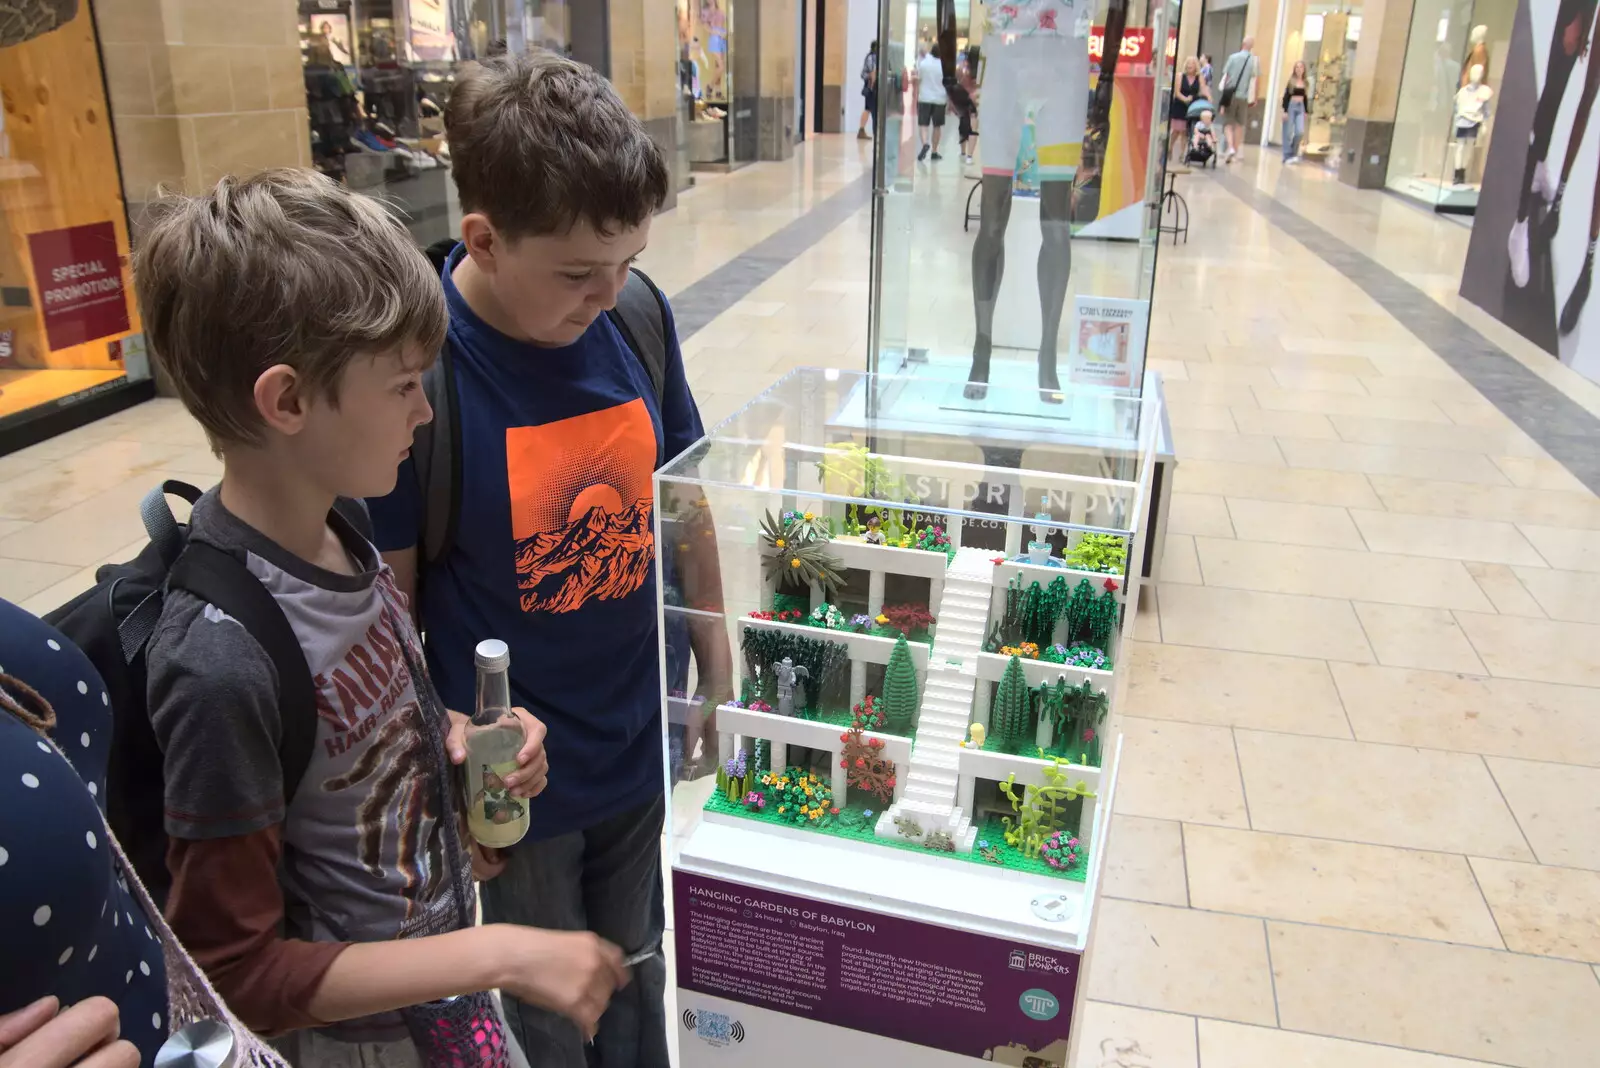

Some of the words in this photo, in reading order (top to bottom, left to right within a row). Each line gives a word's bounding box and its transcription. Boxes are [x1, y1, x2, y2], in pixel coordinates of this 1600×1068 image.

[52, 260, 107, 282] SPECIAL
[44, 276, 119, 304] PROMOTION
[916, 476, 1026, 506] STOR
[689, 886, 742, 904] HANGING
[744, 898, 799, 917] GARDENS
[801, 910, 818, 920] OF
[820, 914, 876, 933] BABYLON
[700, 900, 716, 909] 1400
[717, 903, 738, 914] bricks
[764, 913, 783, 924] hours
[691, 919, 714, 927] wonder
[742, 930, 764, 938] cannot
[766, 935, 792, 944] confirm
[691, 924, 716, 934] location
[729, 932, 749, 941] Based
[772, 943, 796, 951] ancient
[703, 914, 730, 926] Hanging
[731, 920, 758, 931] Gardens
[784, 933, 798, 941] only
[799, 936, 824, 945] ancient
[831, 929, 845, 938] Iraq
[691, 930, 706, 939] they
[756, 944, 770, 952] built
[792, 953, 804, 961] city
[691, 936, 716, 946] Babylon
[718, 942, 739, 952] during
[764, 954, 789, 964] century
[1028, 952, 1058, 965] BRICK
[691, 948, 707, 956] filled
[723, 956, 739, 964] trees
[754, 963, 771, 971] other
[796, 973, 814, 981] water
[703, 958, 728, 967] gardens
[749, 967, 765, 975] from
[778, 974, 811, 986] Euphrates
[744, 955, 770, 965] gardens
[772, 961, 788, 969] were
[842, 952, 874, 963] proposed
[904, 965, 933, 976] Hanging
[934, 971, 964, 982] Gardens
[915, 961, 943, 971] theories
[945, 967, 962, 975] have
[963, 971, 981, 979] been
[1028, 959, 1070, 975] WONDERS
[711, 977, 745, 989] Babylonian
[747, 986, 771, 995] sources
[722, 974, 740, 982] there
[762, 984, 790, 995] surviving
[791, 990, 821, 1001] accounts
[841, 964, 866, 974] instead
[872, 972, 894, 980] where
[896, 977, 945, 991] archaeological
[841, 971, 870, 981] revealed
[876, 979, 906, 989] complex
[907, 986, 936, 995] network
[928, 977, 941, 985] city
[951, 981, 980, 992] Nineveh
[692, 978, 737, 993] archaeological
[738, 989, 766, 1000] evidence
[767, 995, 779, 1003] has
[795, 1002, 812, 1011] been
[840, 983, 870, 994] irrigation
[888, 993, 905, 1002] large
[841, 977, 861, 985] canals
[877, 984, 896, 993] dams
[898, 990, 918, 998] which
[920, 995, 935, 1003] may
[936, 997, 953, 1005] have
[955, 1002, 986, 1013] provided
